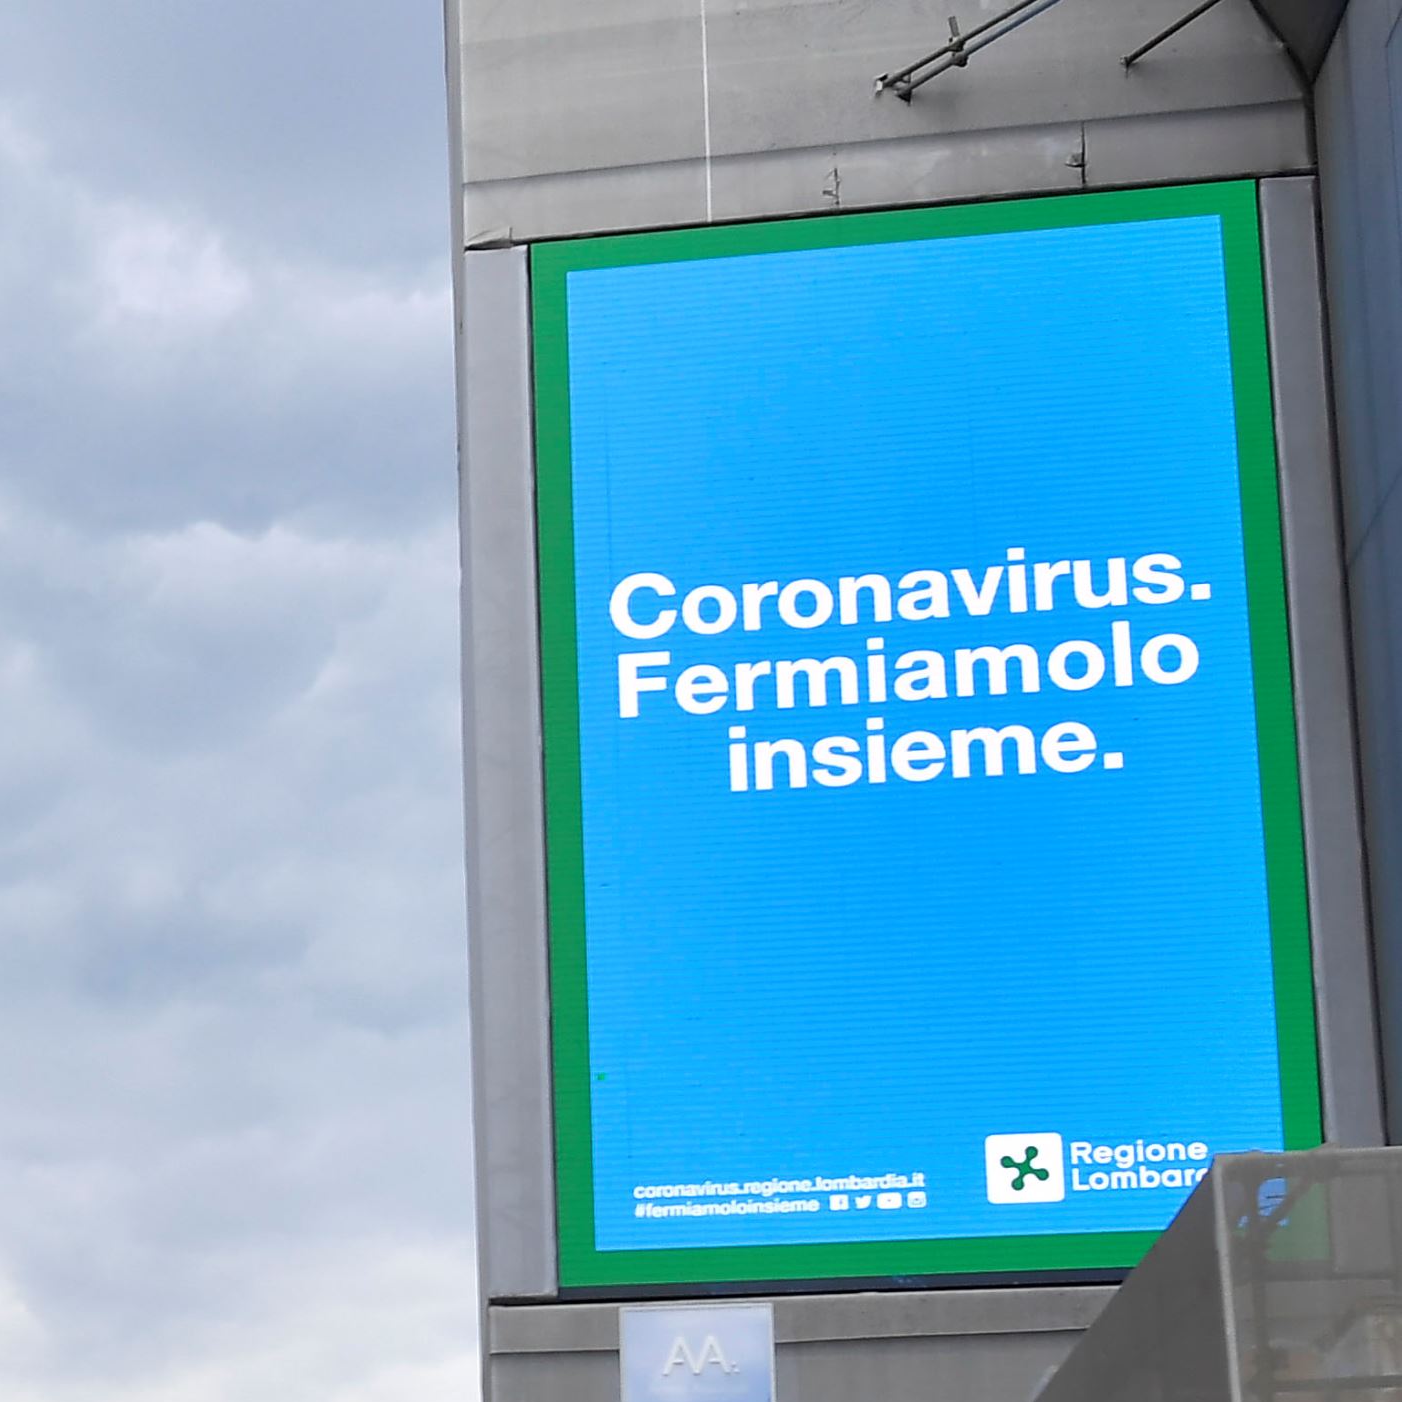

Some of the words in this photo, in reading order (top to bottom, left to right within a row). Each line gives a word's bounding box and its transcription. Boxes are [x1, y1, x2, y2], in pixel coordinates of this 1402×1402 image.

[608, 547, 1212, 640] Coronavirus.
[617, 620, 1200, 719] Fermiamolo
[728, 716, 1125, 792] insieme.
[1070, 1139, 1209, 1169] Regione
[633, 1172, 926, 1199] coronavirus.regione.lombardia.it
[634, 1196, 821, 1218] #fermiamoloinsieme
